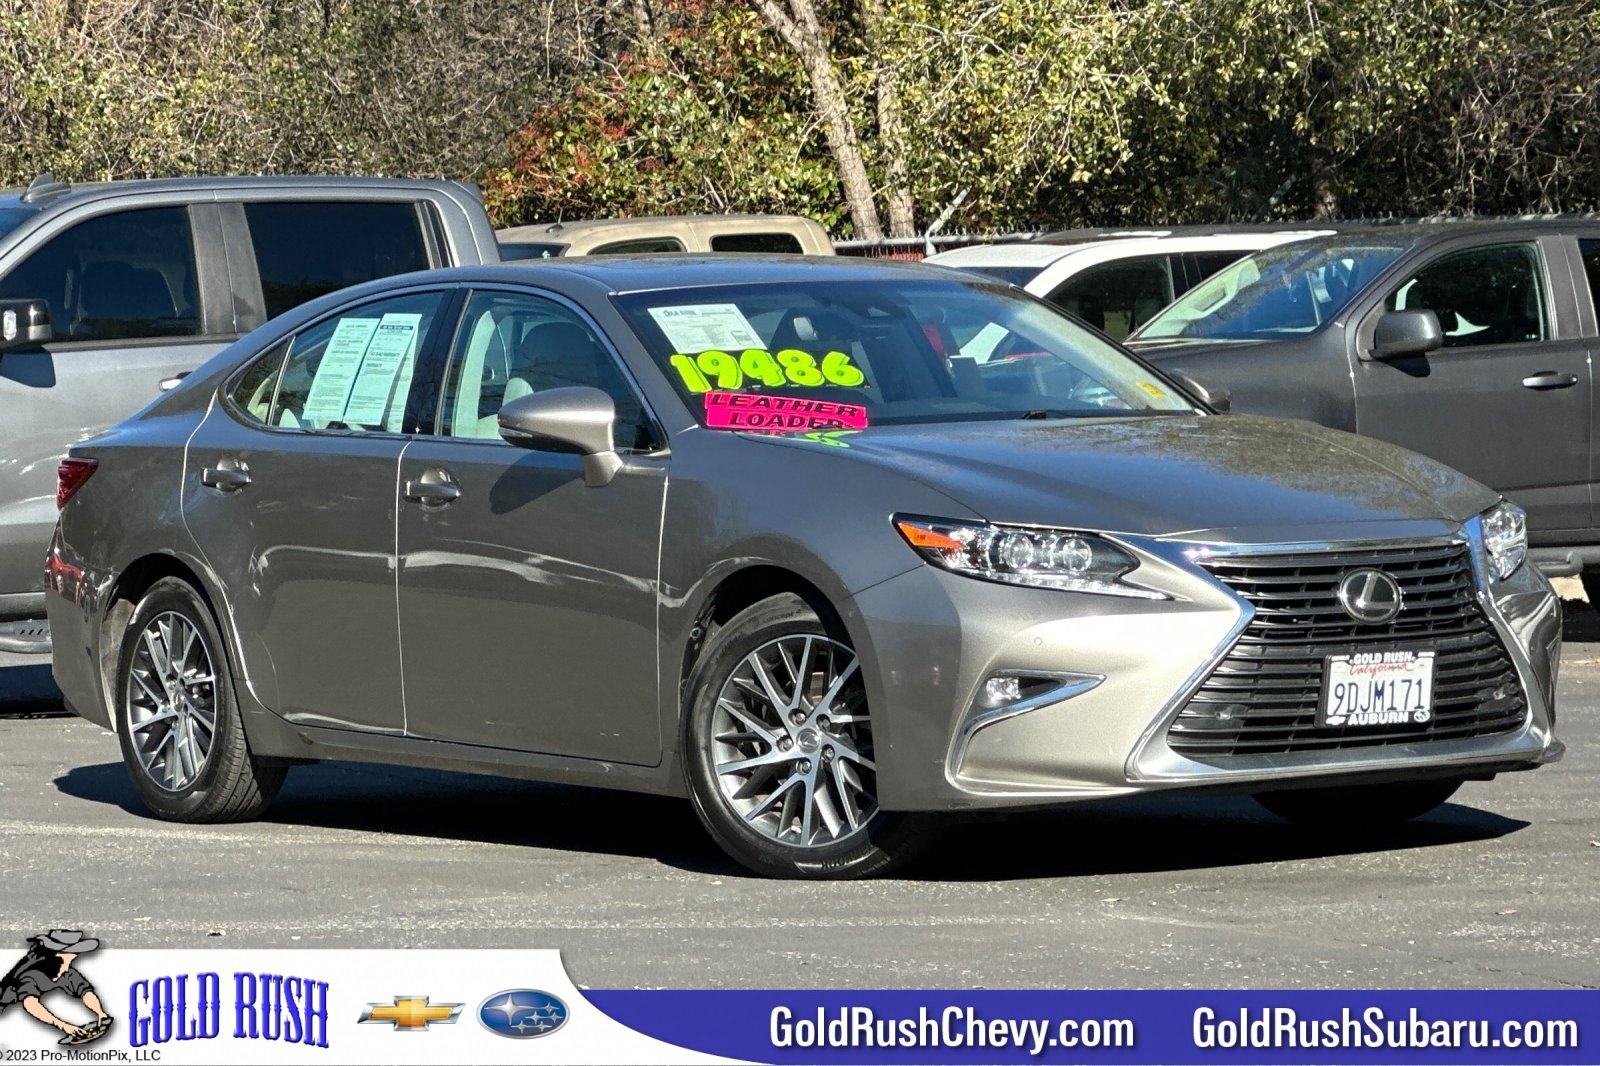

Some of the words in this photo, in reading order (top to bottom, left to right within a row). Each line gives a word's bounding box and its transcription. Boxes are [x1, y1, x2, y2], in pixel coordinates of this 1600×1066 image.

[670, 348, 864, 392] 19486
[710, 393, 858, 417] LEATHER
[1354, 652, 1383, 664] GOLD
[1384, 651, 1413, 663] RUSH
[1349, 662, 1414, 679] California
[1333, 678, 1425, 715] 9DJM171
[1348, 711, 1409, 725] AUBURN
